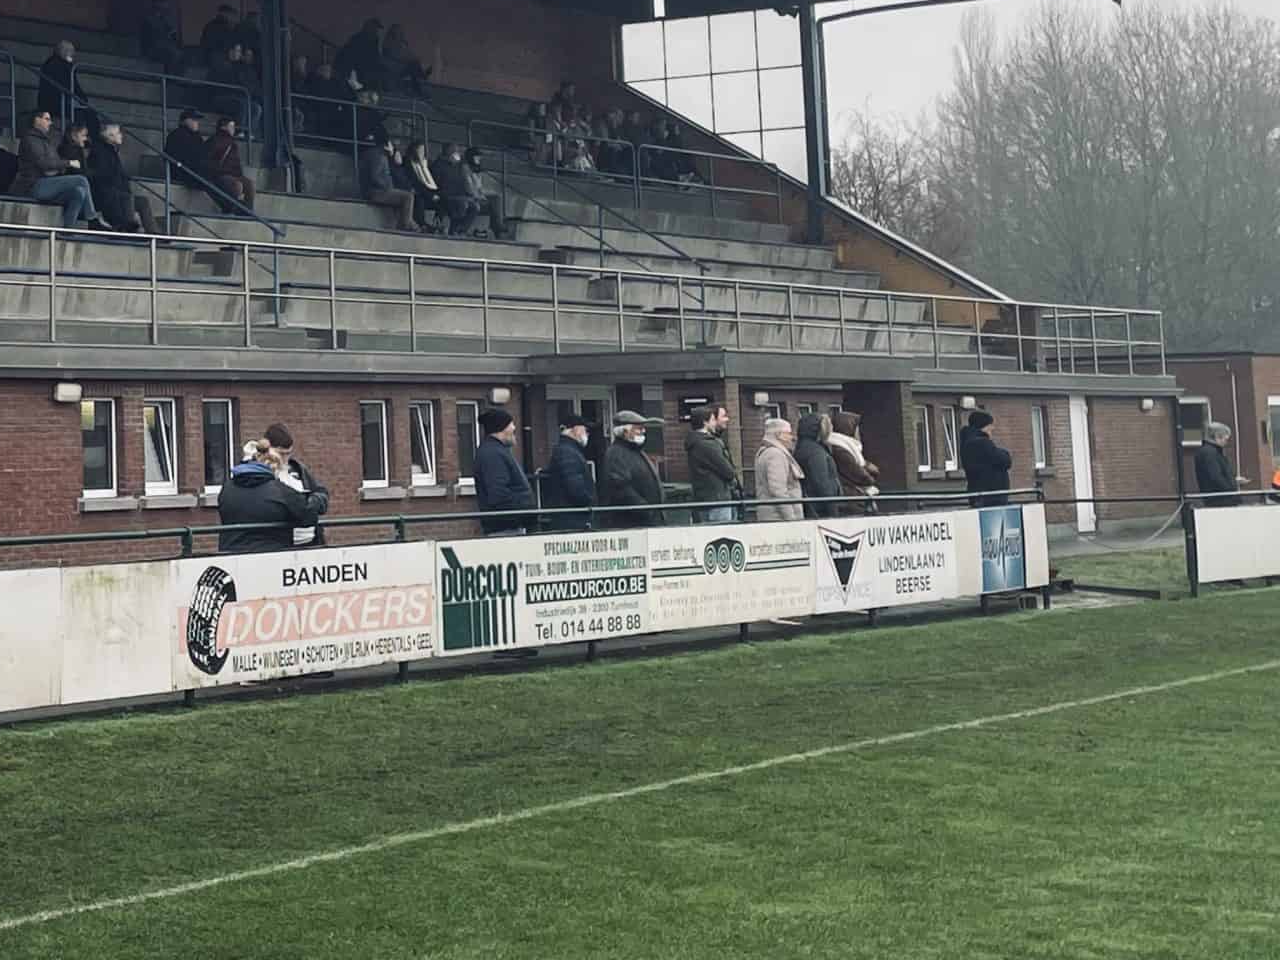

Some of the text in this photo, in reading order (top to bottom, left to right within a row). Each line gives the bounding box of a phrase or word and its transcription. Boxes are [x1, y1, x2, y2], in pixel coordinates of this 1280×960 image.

[867, 522, 953, 547] UW VAKHANDEL
[282, 562, 368, 587] BANDEN
[879, 552, 935, 573] LINDENLAAN
[527, 575, 646, 602] WWW.DURCOLO.BE
[895, 575, 932, 594] BEERSE
[226, 590, 428, 641] DONCKERS
[535, 614, 641, 641] Tel. 014 44 88 88
[232, 653, 258, 672] MALLE
[305, 643, 339, 664] SCHOTEN
